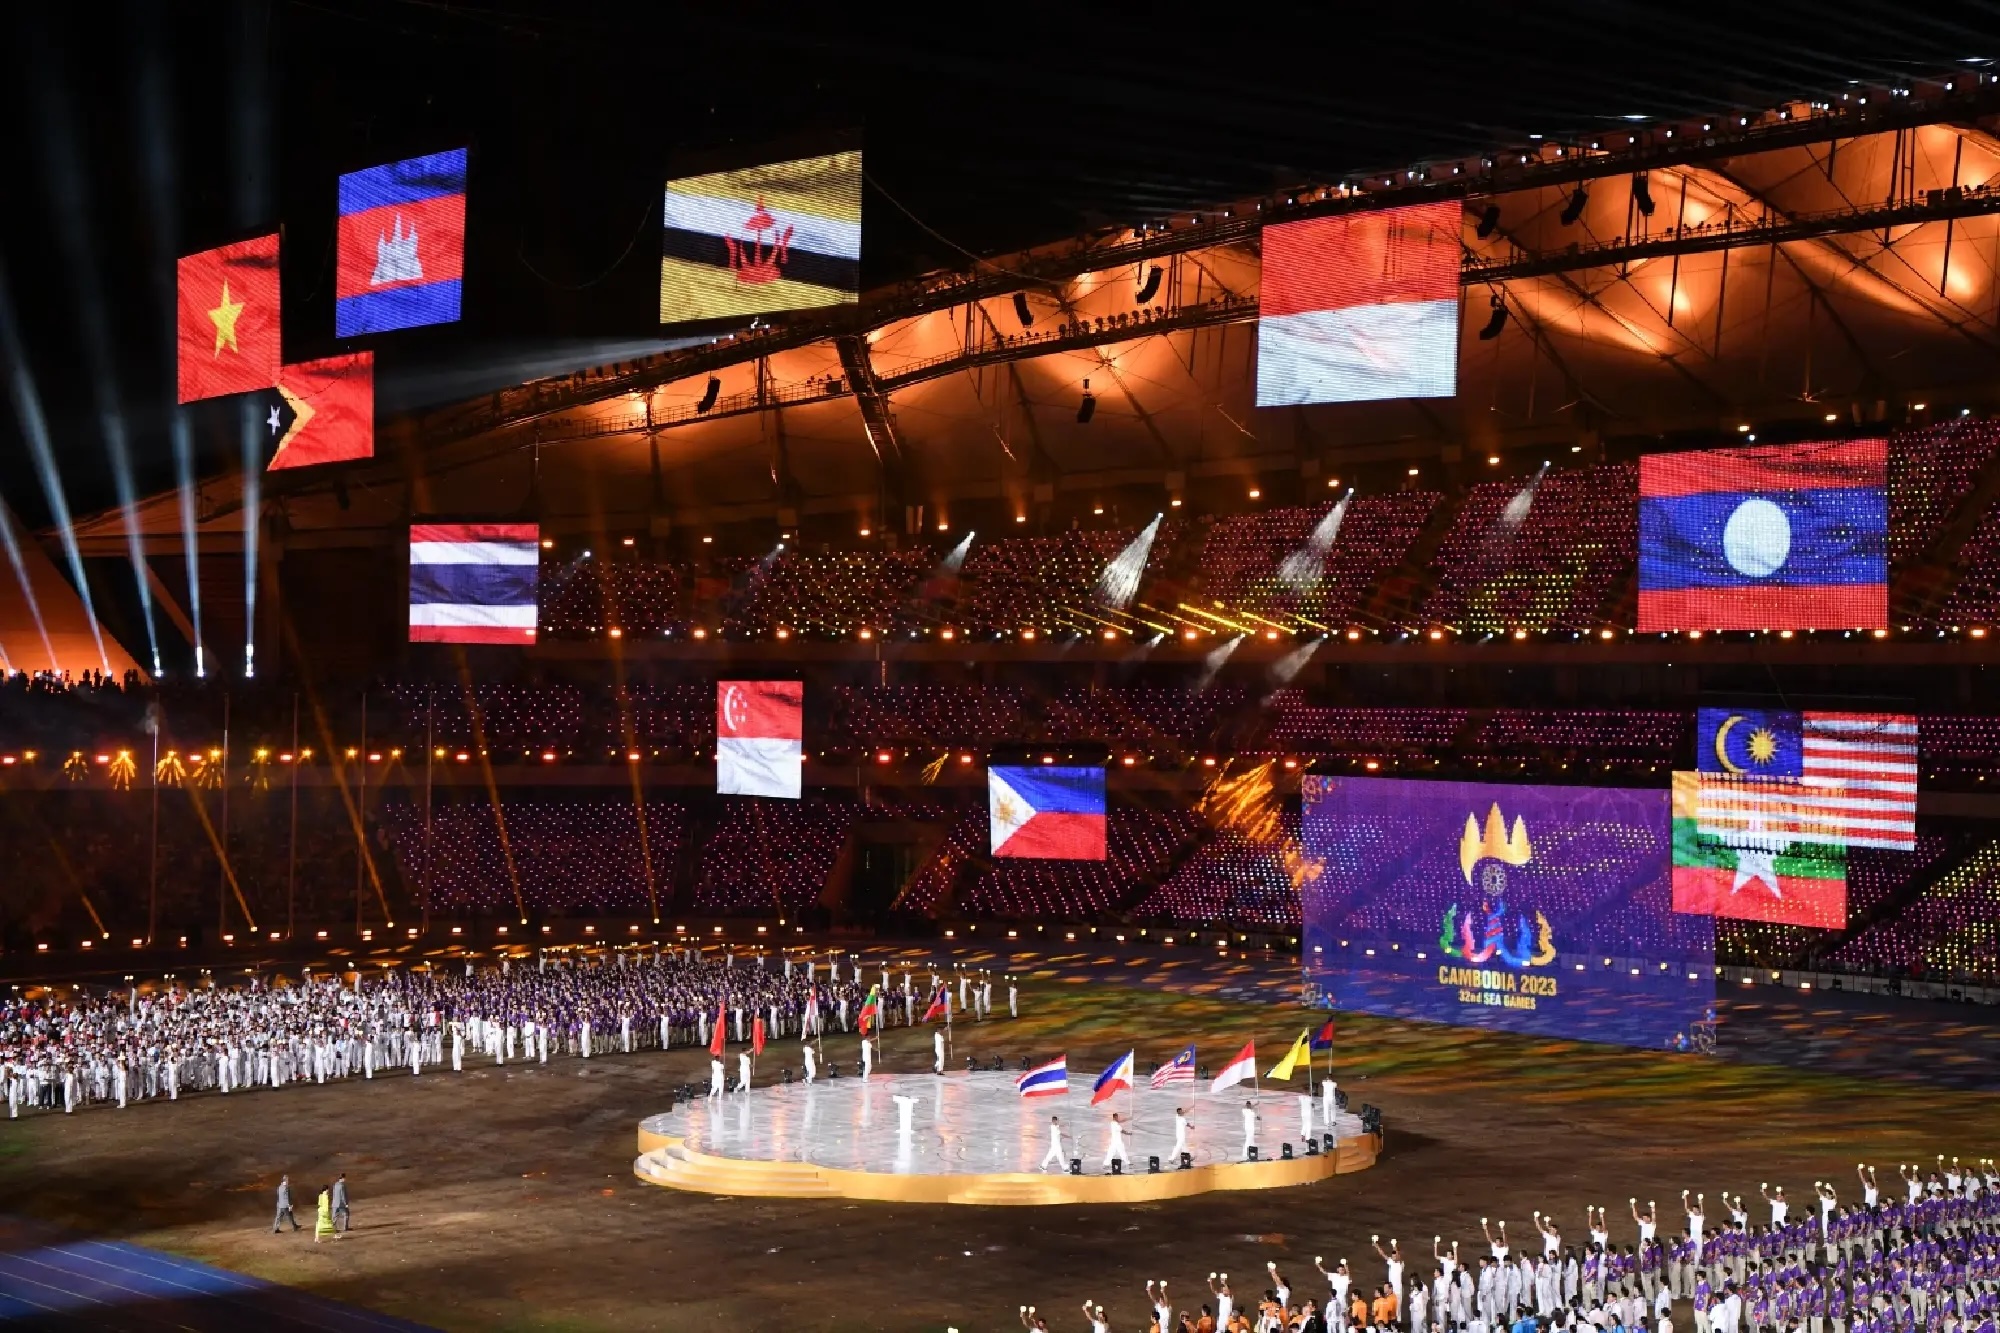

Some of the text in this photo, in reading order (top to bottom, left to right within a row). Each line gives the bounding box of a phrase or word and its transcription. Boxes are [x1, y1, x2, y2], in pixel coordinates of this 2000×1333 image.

[1439, 966, 1557, 996] CAMBODIA 2023
[1458, 990, 1536, 1009] 32nd SEA GAMES
